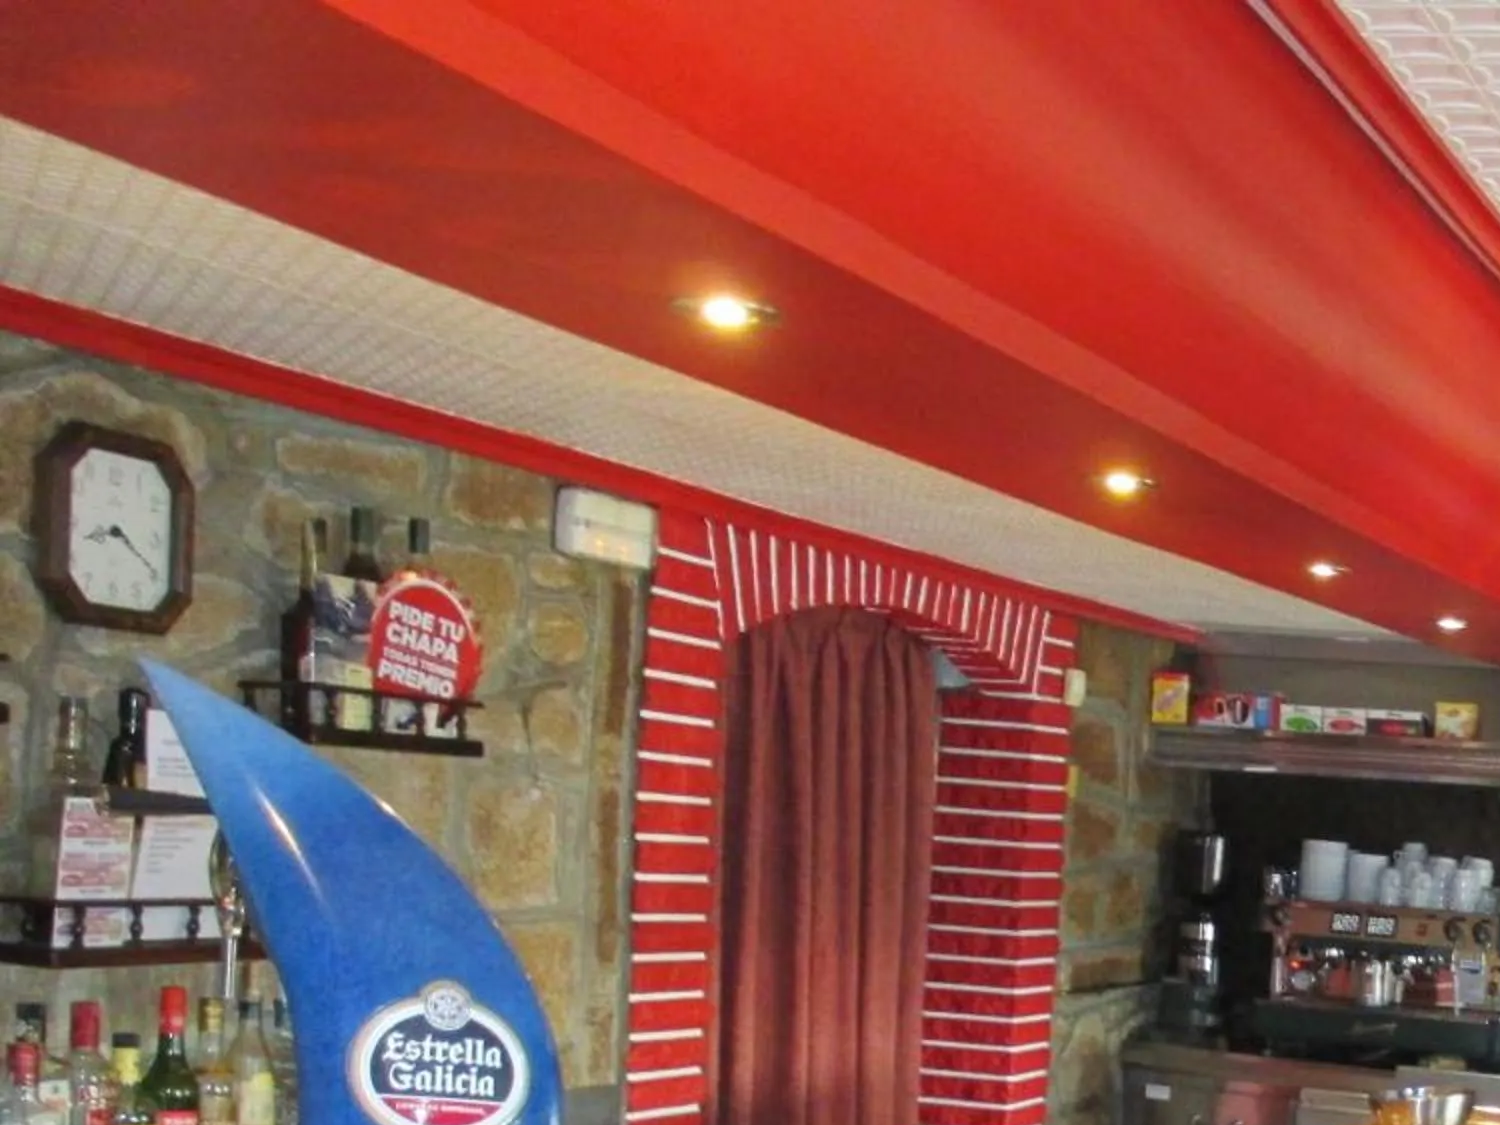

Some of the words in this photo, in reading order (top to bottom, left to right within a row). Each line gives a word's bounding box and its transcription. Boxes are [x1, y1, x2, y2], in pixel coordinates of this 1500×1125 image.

[389, 599, 436, 633] PIDE
[439, 616, 465, 643] TU
[386, 621, 459, 663] CHAPA
[377, 658, 455, 699] PREMIO
[382, 1031, 502, 1069] Estrella
[389, 1063, 495, 1097] Galicia
